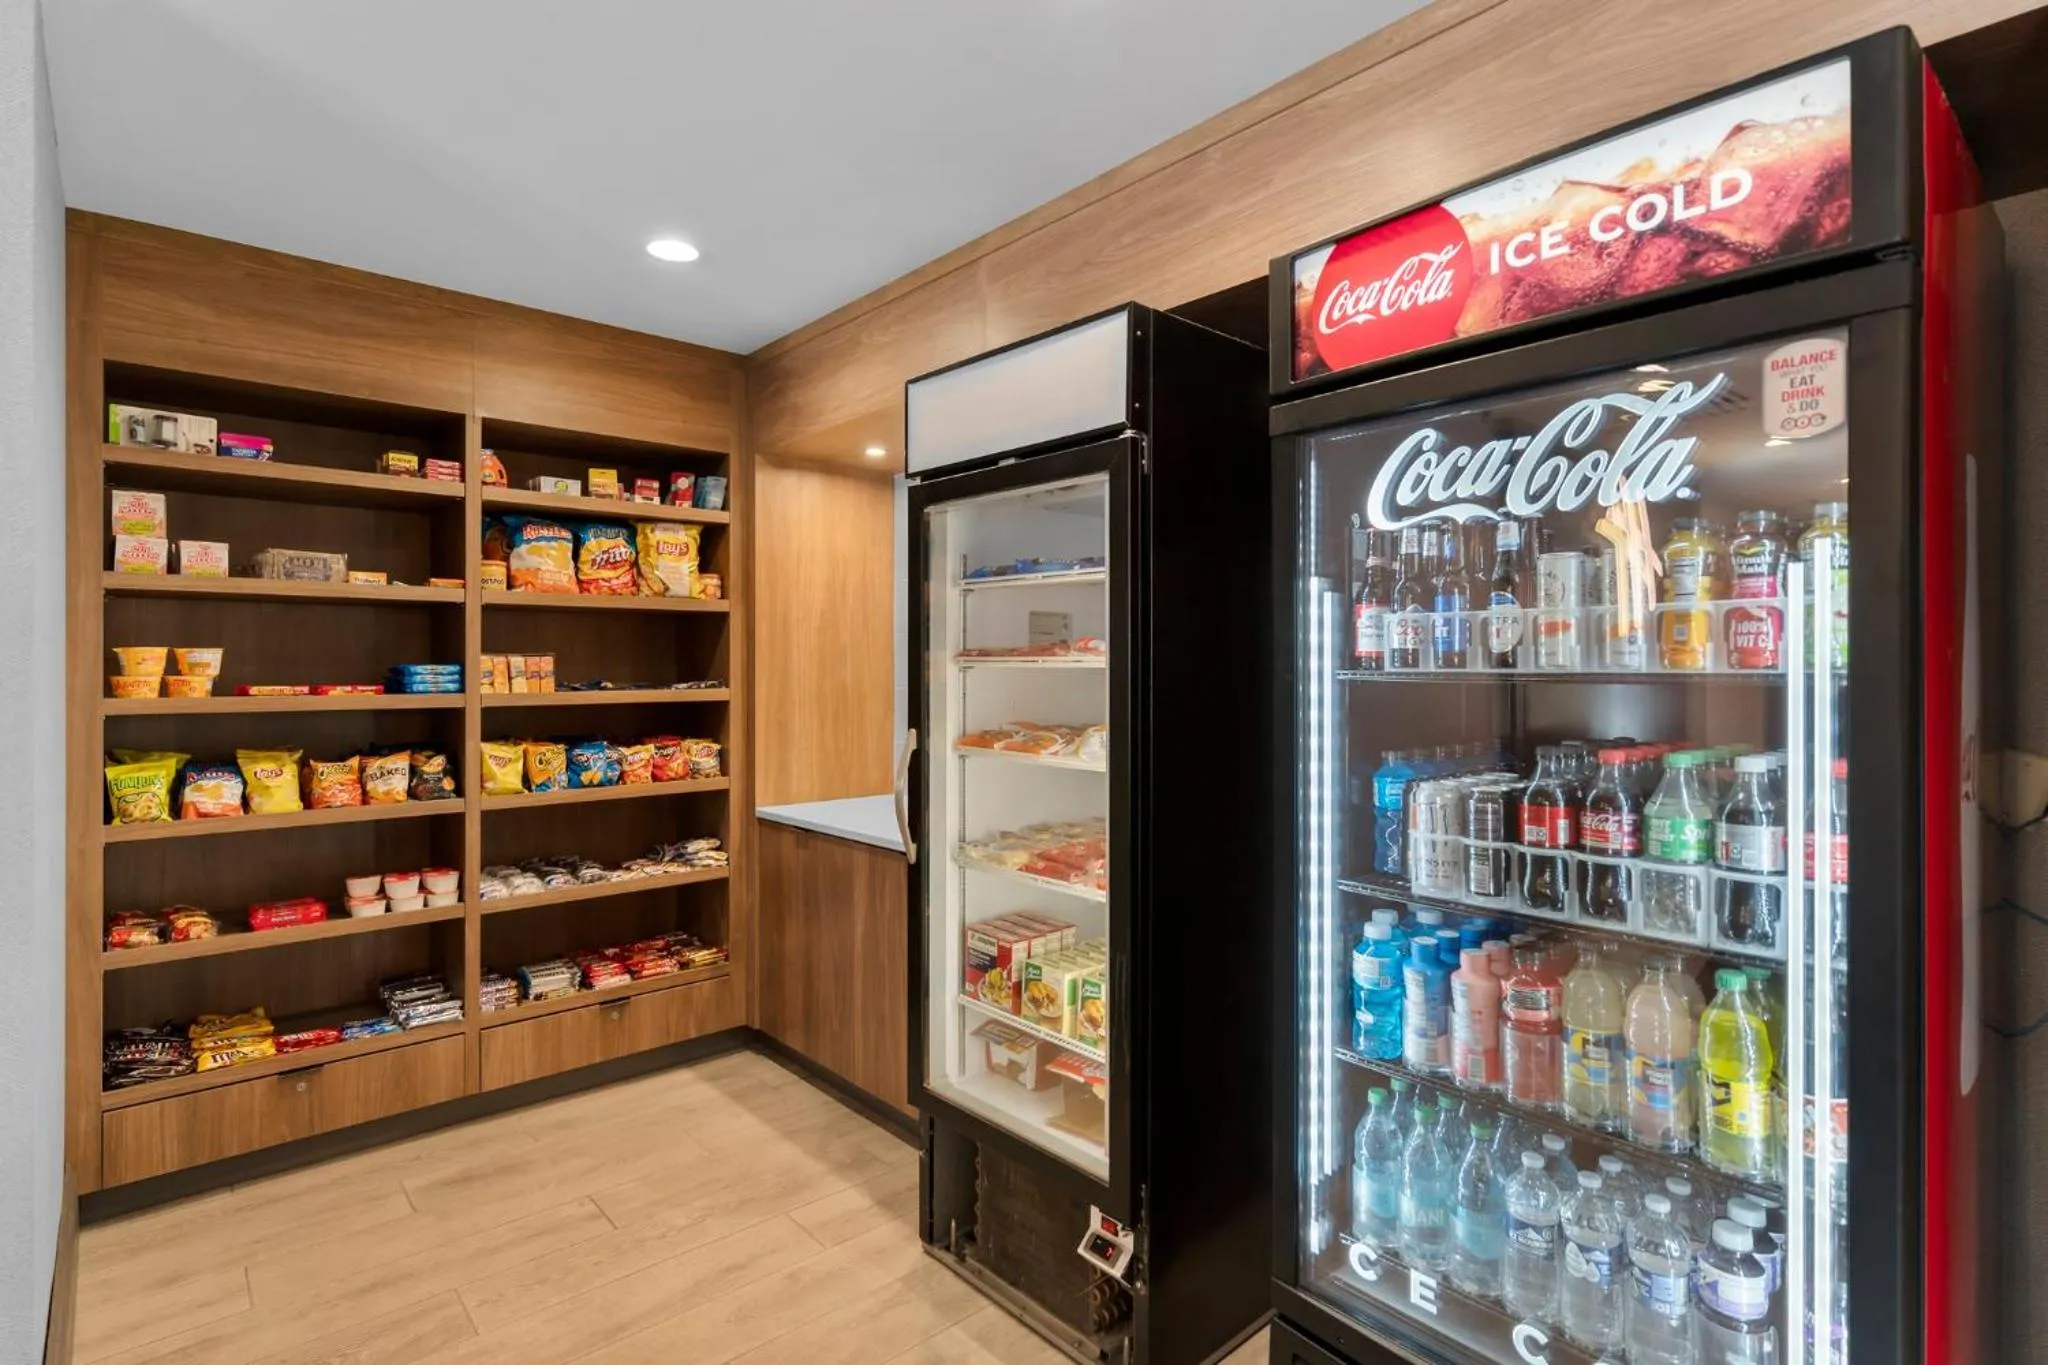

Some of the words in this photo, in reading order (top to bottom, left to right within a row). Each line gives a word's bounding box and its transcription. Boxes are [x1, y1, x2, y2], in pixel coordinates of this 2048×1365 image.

[1488, 222, 1571, 275] ICE
[1588, 168, 1754, 242] COLD
[1318, 240, 1464, 335] Coca-Cola
[1770, 349, 1838, 372] BALANCE
[1789, 374, 1816, 389] EAT
[1780, 386, 1825, 403] DRINK
[1799, 398, 1820, 412] DO
[1366, 372, 1726, 531] Coca-Cola
[1736, 633, 1756, 648] VIT
[370, 766, 407, 782] BAKED
